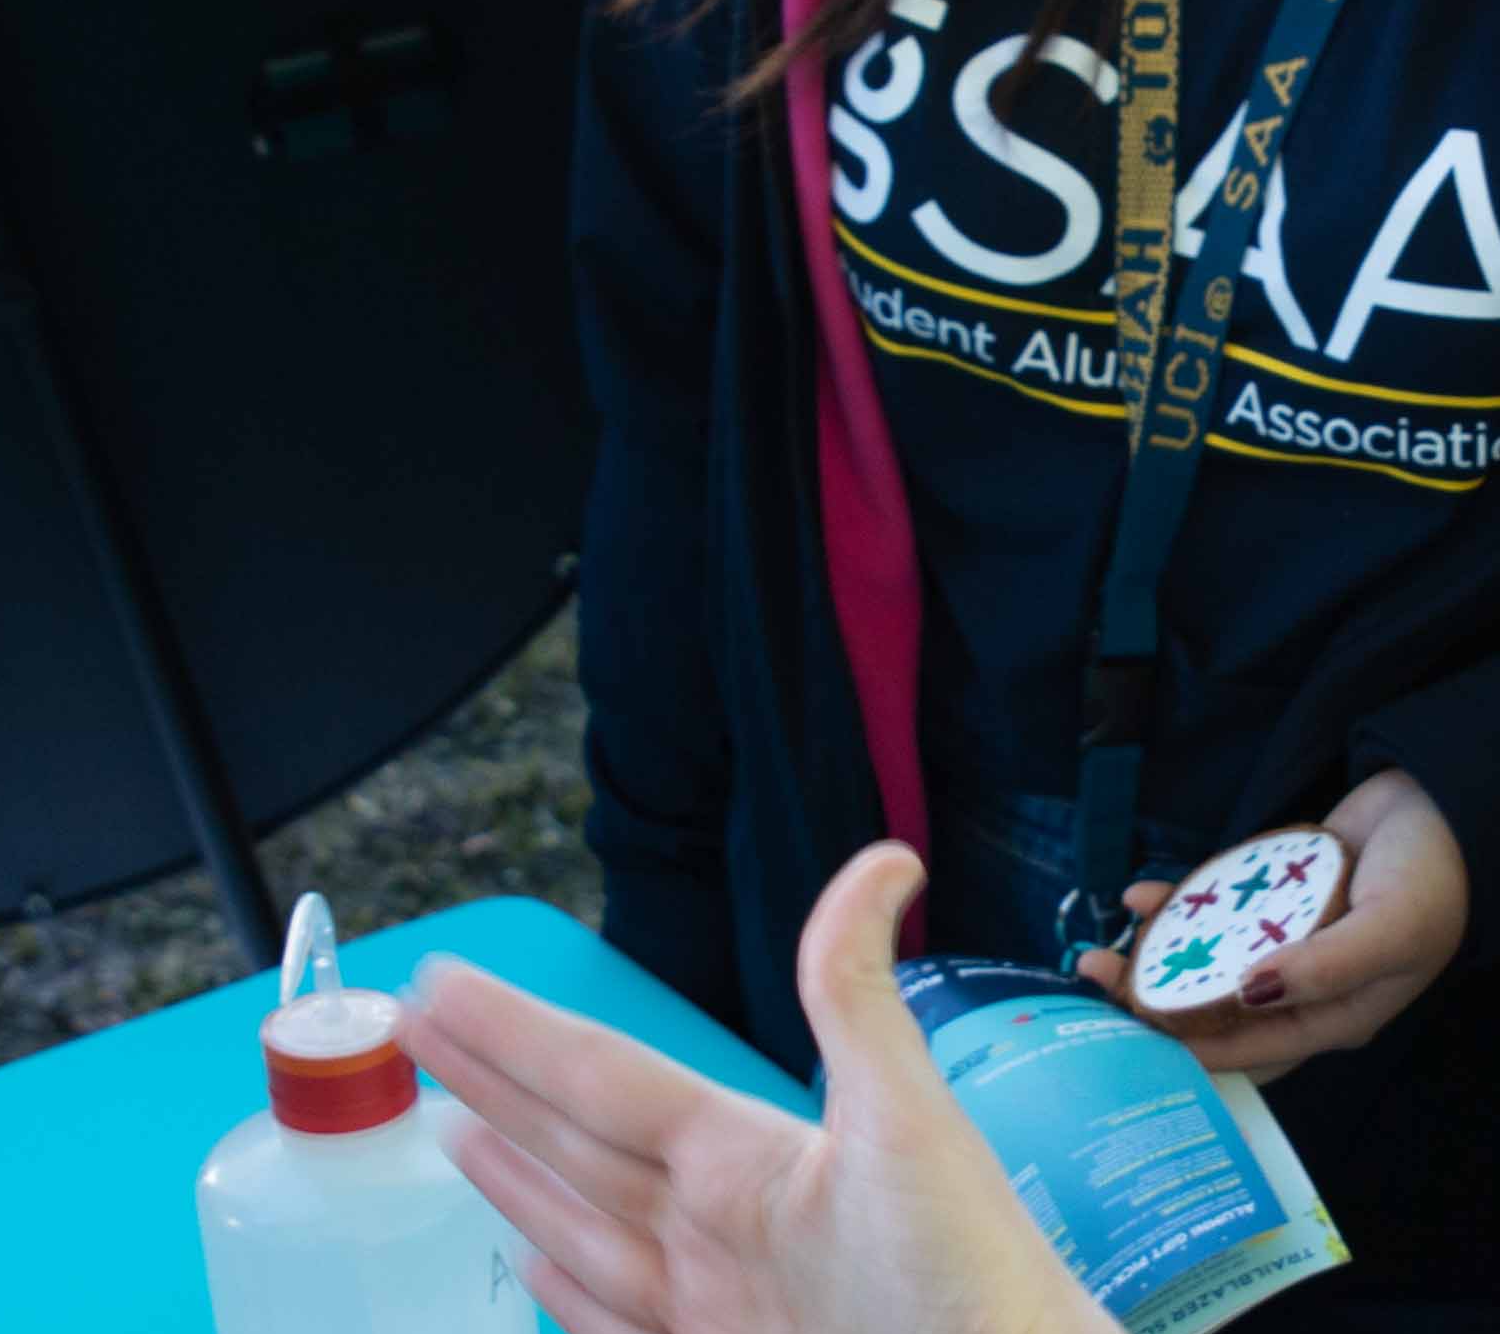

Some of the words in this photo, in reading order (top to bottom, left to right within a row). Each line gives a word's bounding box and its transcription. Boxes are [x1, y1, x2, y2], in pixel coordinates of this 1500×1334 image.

[1149, 324, 1218, 453] UCI
[1223, 54, 1308, 213] SAA
[1169, 1245, 1315, 1322] TRAILBLAZER
